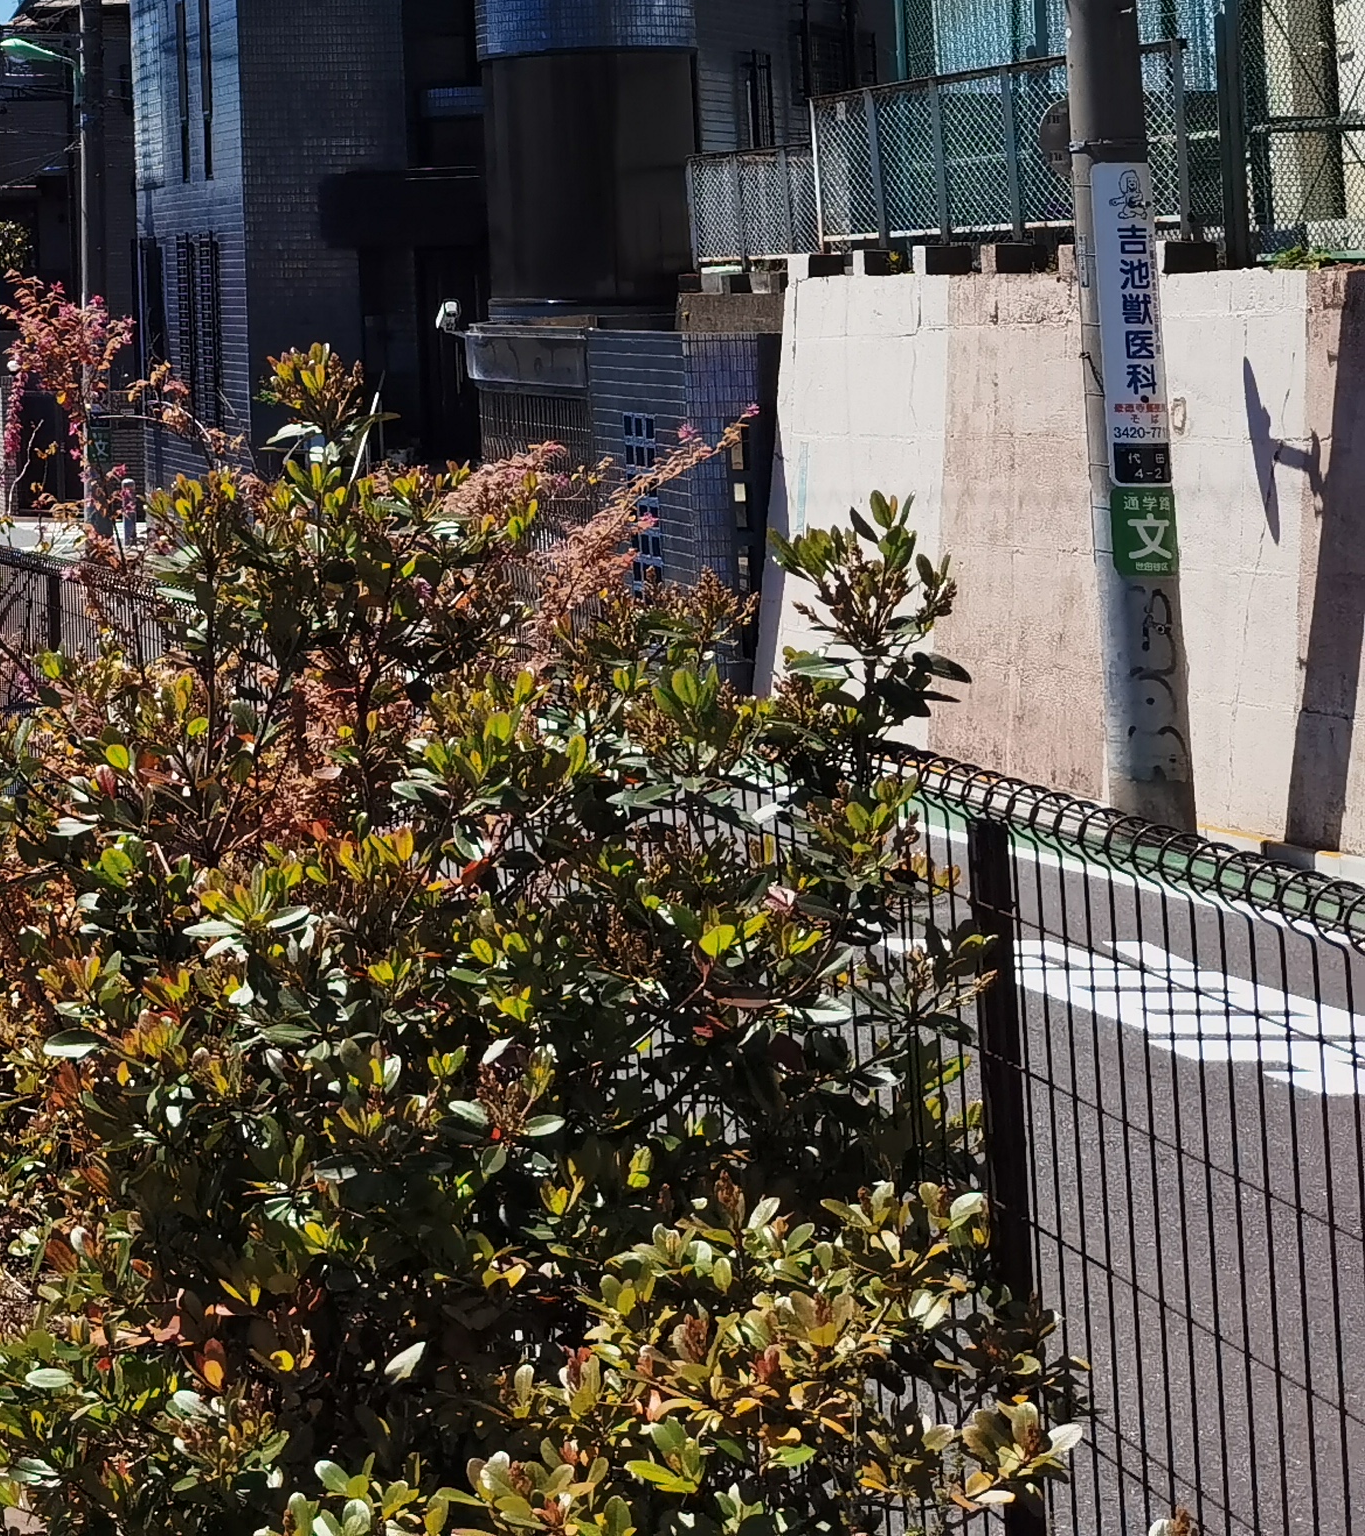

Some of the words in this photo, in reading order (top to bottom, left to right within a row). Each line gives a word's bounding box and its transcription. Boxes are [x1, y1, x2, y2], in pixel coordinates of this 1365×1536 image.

[1116, 224, 1157, 396] 吉池獣医科
[1129, 453, 1165, 464] 代田
[1124, 496, 1170, 510] 通学路
[1128, 513, 1172, 559] 文
